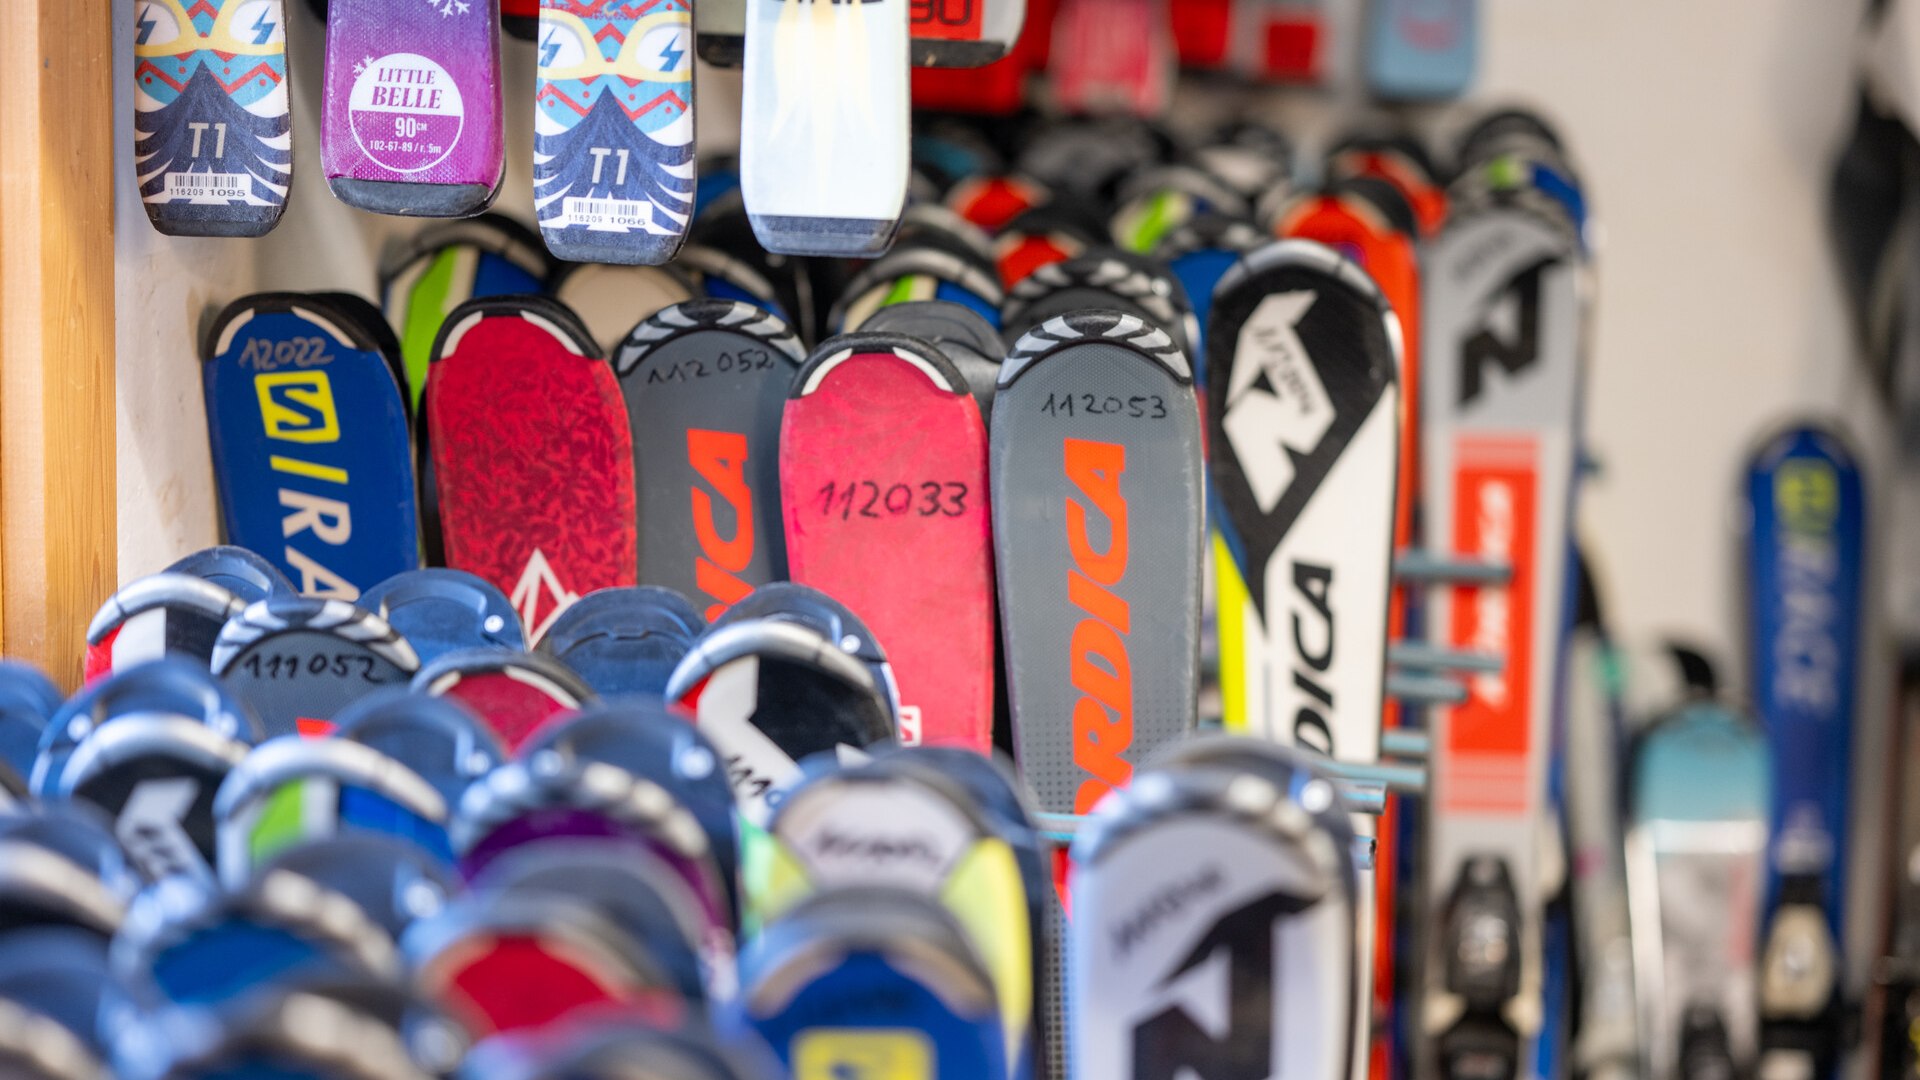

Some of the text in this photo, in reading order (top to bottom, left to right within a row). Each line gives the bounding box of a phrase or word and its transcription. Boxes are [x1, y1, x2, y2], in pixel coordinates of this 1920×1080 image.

[378, 67, 437, 84] LITTLE
[371, 86, 442, 109] BELLE
[188, 122, 227, 158] T1
[590, 147, 629, 185] T1
[170, 188, 204, 196] 116209
[568, 214, 646, 226] 116209 1066
[1041, 393, 1167, 419] 112053
[819, 481, 968, 521] 112033
